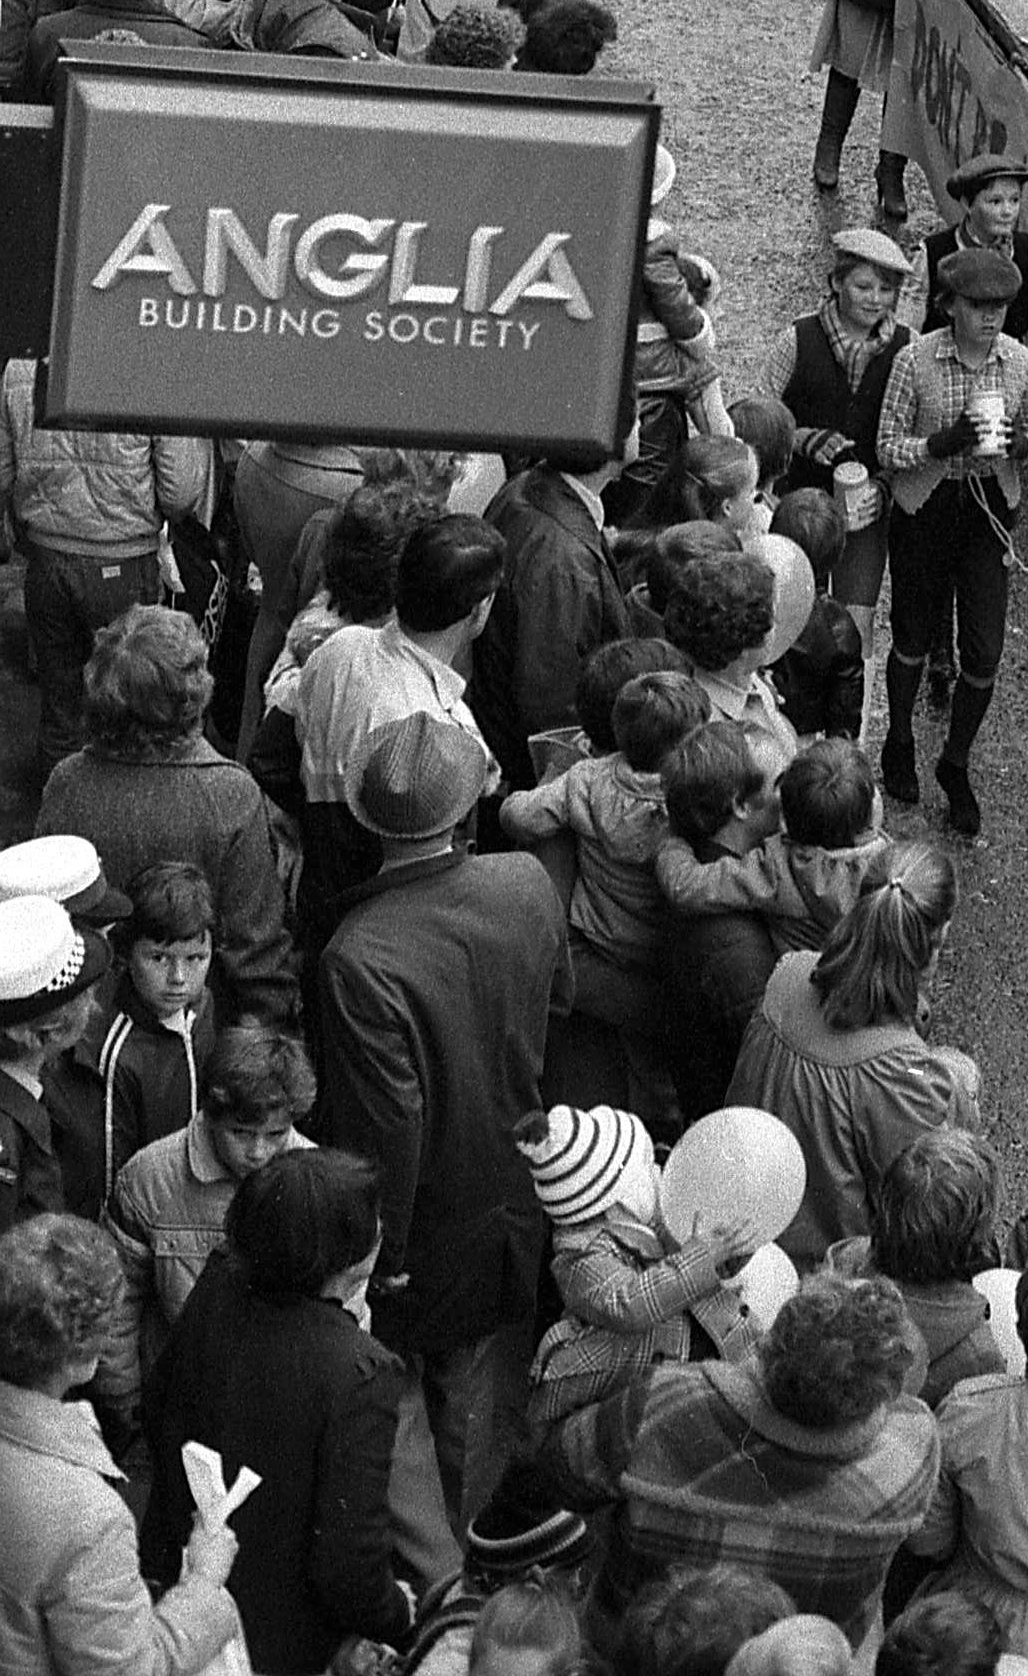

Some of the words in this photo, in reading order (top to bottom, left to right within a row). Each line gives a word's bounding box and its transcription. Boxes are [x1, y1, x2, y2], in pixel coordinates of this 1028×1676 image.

[90, 202, 595, 322] ANGLIA
[138, 297, 341, 339] BUILDING
[362, 310, 542, 351] SOCIETY
